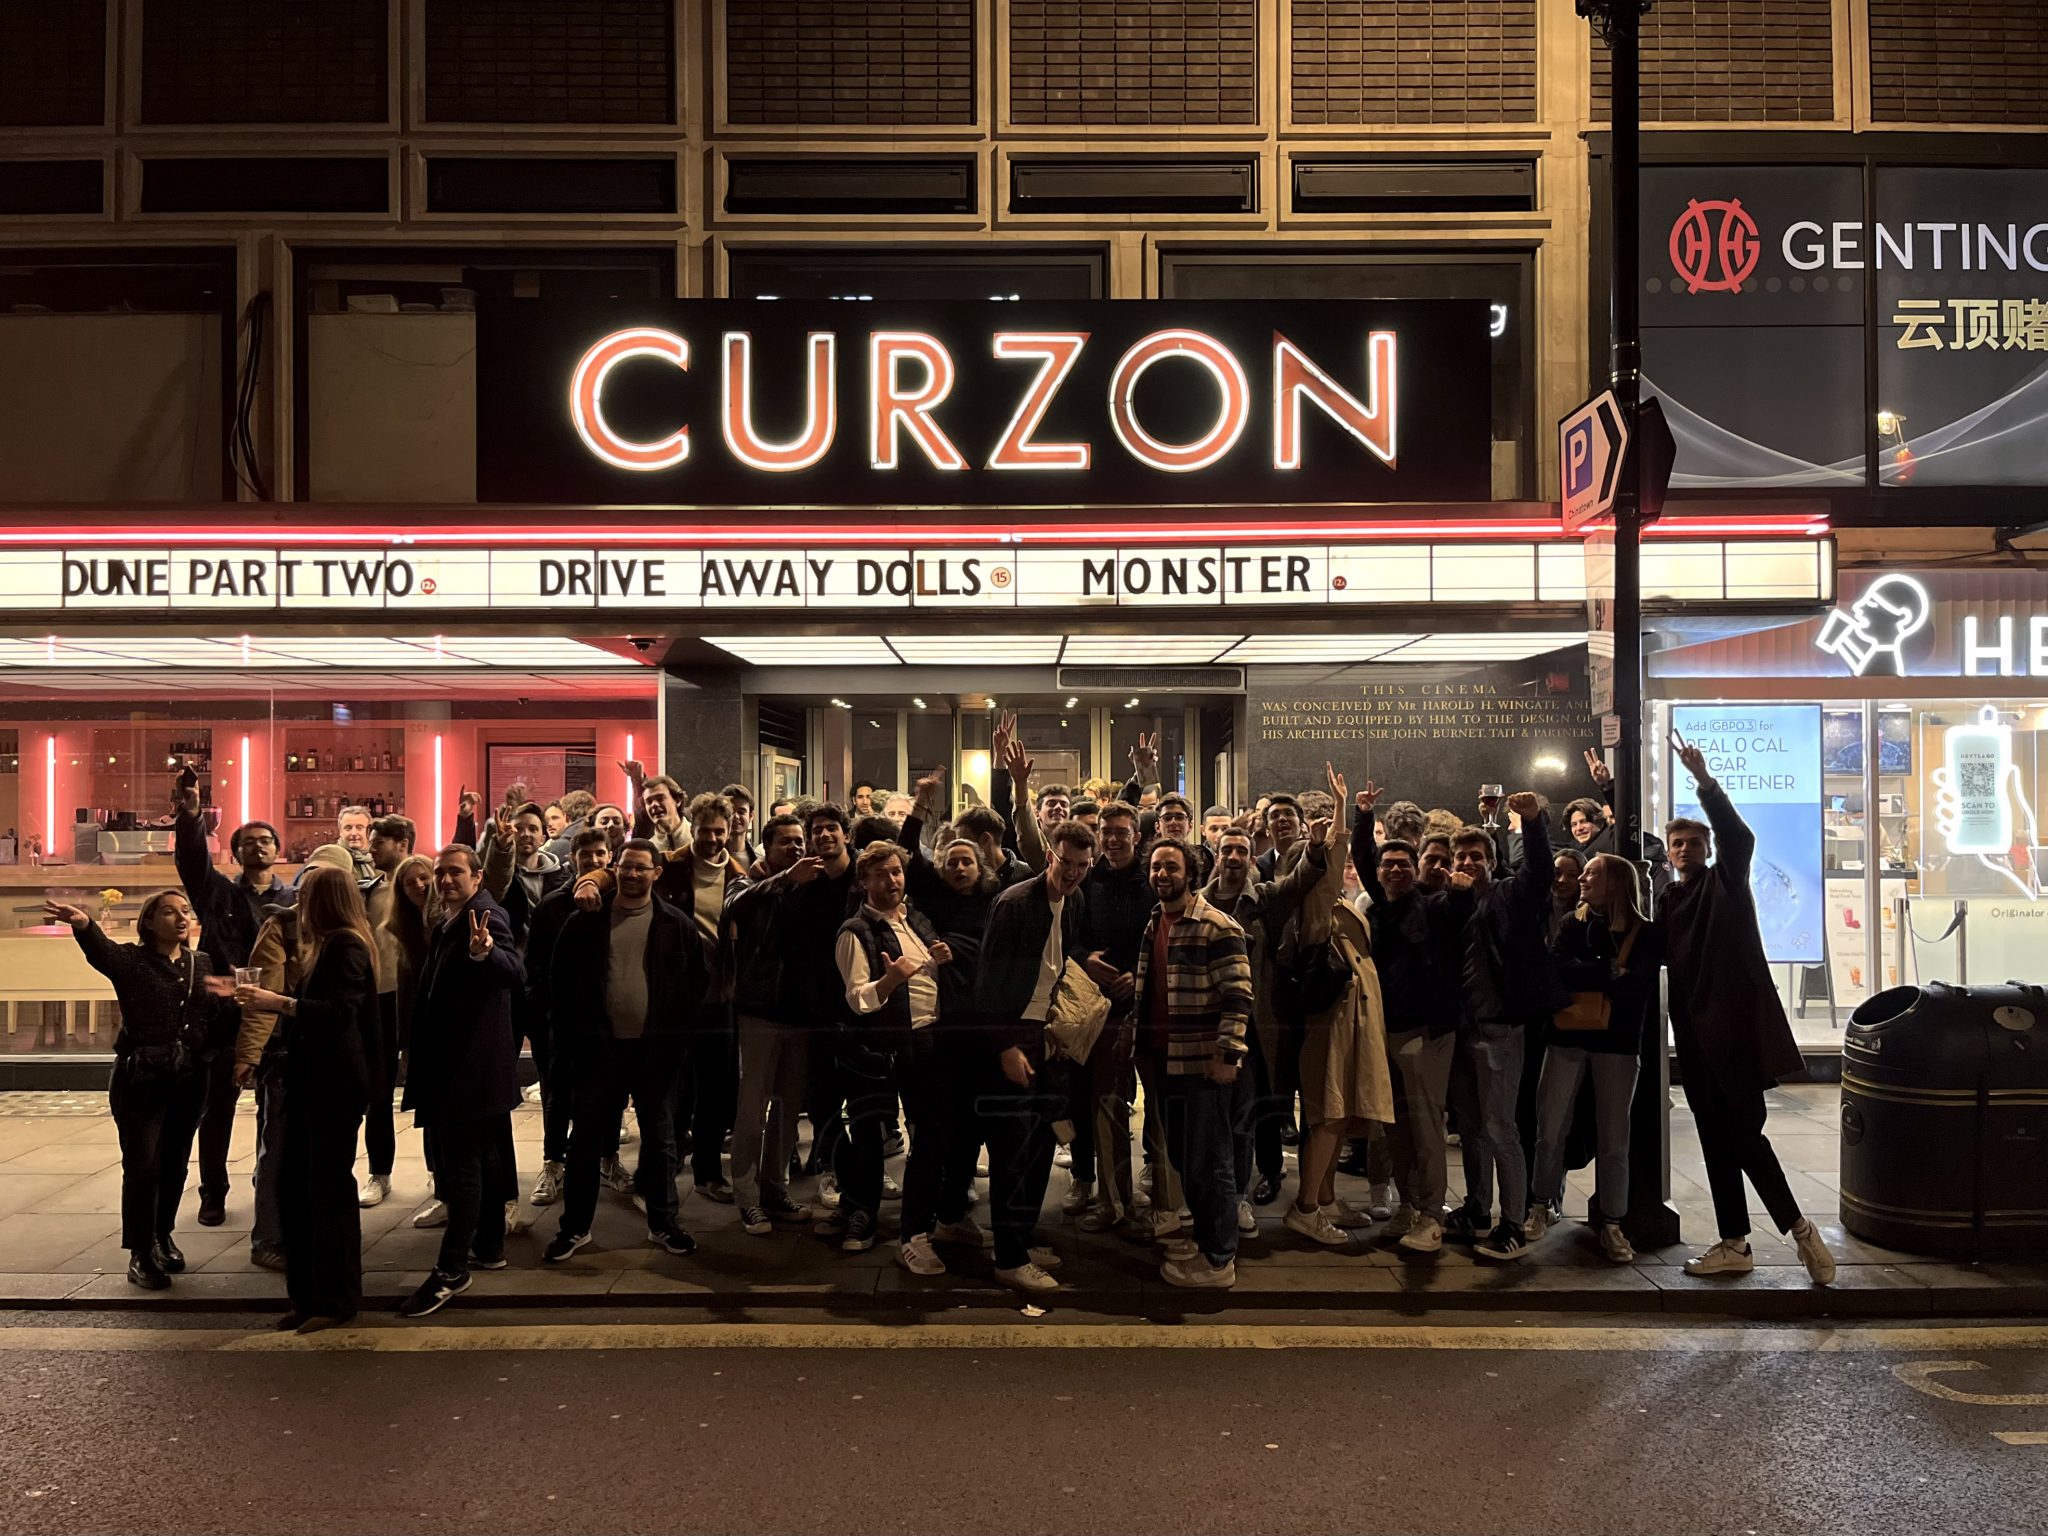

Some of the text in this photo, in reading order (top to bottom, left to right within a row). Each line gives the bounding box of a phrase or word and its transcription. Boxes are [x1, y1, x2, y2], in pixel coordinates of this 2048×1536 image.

[1781, 221, 2048, 270] GENTING
[1892, 299, 2048, 351] 云顶赌
[571, 328, 1397, 472] CURZON
[1569, 428, 1588, 490] P
[1568, 499, 1594, 519] Chinatown
[63, 559, 169, 597] DUNE
[188, 559, 302, 597] PART
[313, 559, 415, 597] TWO
[540, 559, 667, 597] DRIVE
[700, 558, 831, 597] AWAY
[857, 558, 982, 597] DOLLS
[1082, 555, 1311, 595] MONSTER
[1360, 685, 1497, 695] THIS CINEMA
[1262, 701, 1288, 711] WAS
[1293, 701, 1372, 711] CONCEIVED
[1378, 701, 1393, 711] BY
[1423, 700, 1475, 710] HAROLD
[1497, 700, 1559, 710] WINGATE
[1262, 715, 1299, 726] BUILT
[1304, 715, 1332, 725] AND
[1336, 715, 1402, 726] EQUIPPED
[1409, 715, 1424, 725] BY
[1429, 714, 1456, 725] HIM
[1462, 714, 1480, 724] TO
[1486, 714, 1514, 724] THE
[1520, 714, 1570, 724] DESIGN
[1685, 720, 1707, 731] Add
[1759, 720, 1775, 731] for
[1262, 729, 1283, 739] HIS
[1287, 729, 1365, 739] ARCHITECTS
[1369, 729, 1389, 739] SIR
[1391, 729, 1427, 740] JOHN
[1521, 728, 1530, 738] &
[1534, 728, 1595, 738] PARTNERS
[1751, 737, 1789, 753] CAL
[1706, 756, 1748, 772] GAR
[1685, 775, 1796, 790] SETENER
[1991, 908, 2044, 918] Originator
